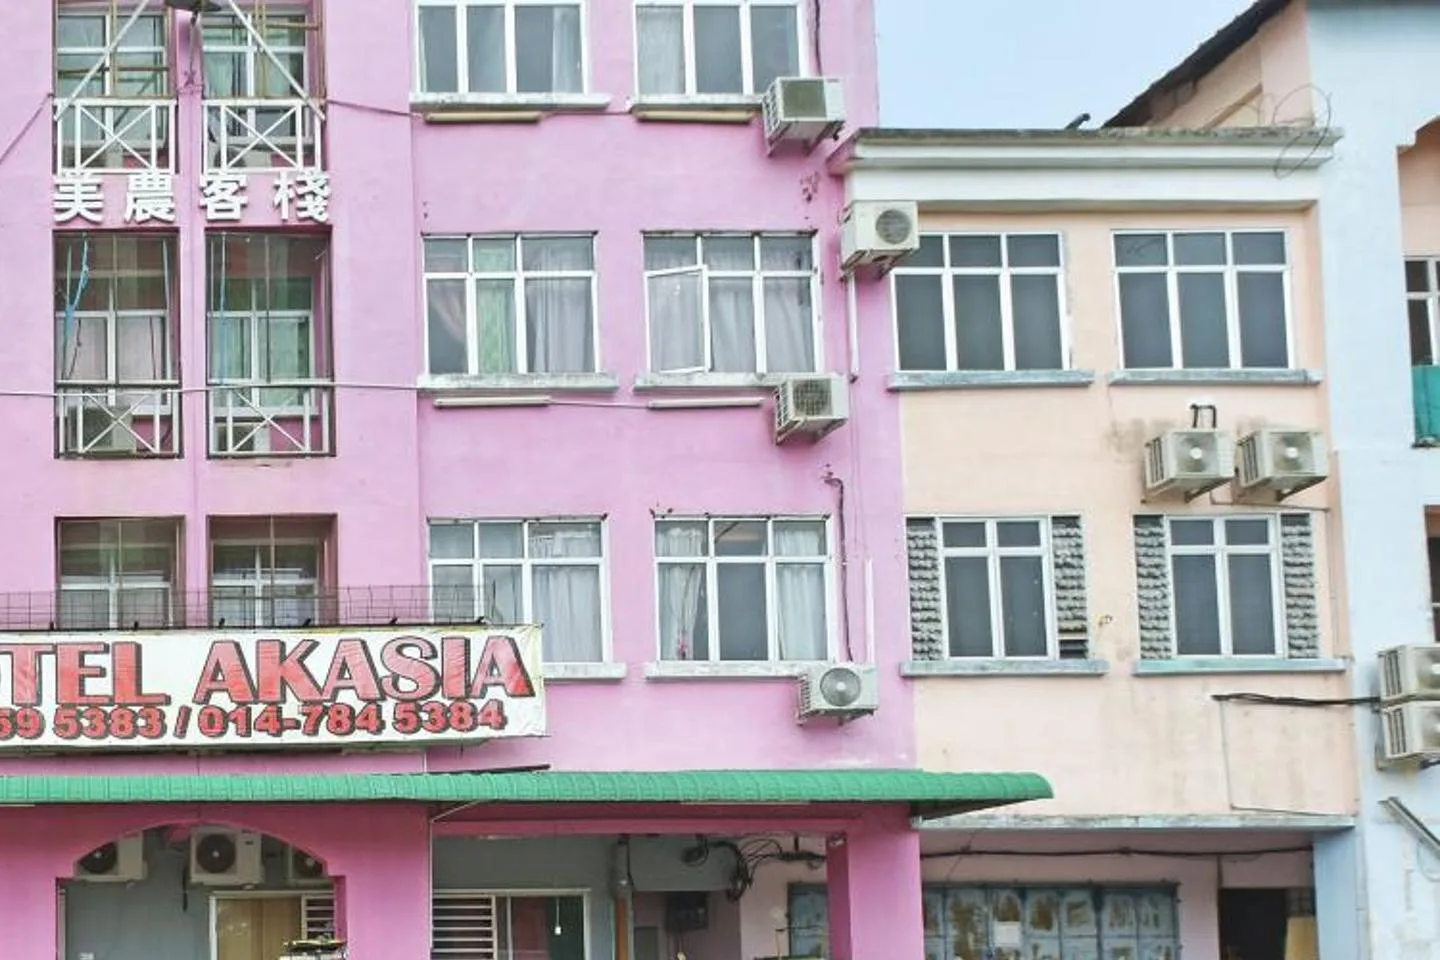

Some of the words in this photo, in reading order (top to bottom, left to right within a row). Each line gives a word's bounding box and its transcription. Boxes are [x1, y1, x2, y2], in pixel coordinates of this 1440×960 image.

[53, 169, 330, 223] 美農客棧
[192, 636, 536, 705] AKASIA
[54, 706, 167, 740] 5383
[196, 702, 383, 738] 014-784
[392, 699, 508, 734] 5384
